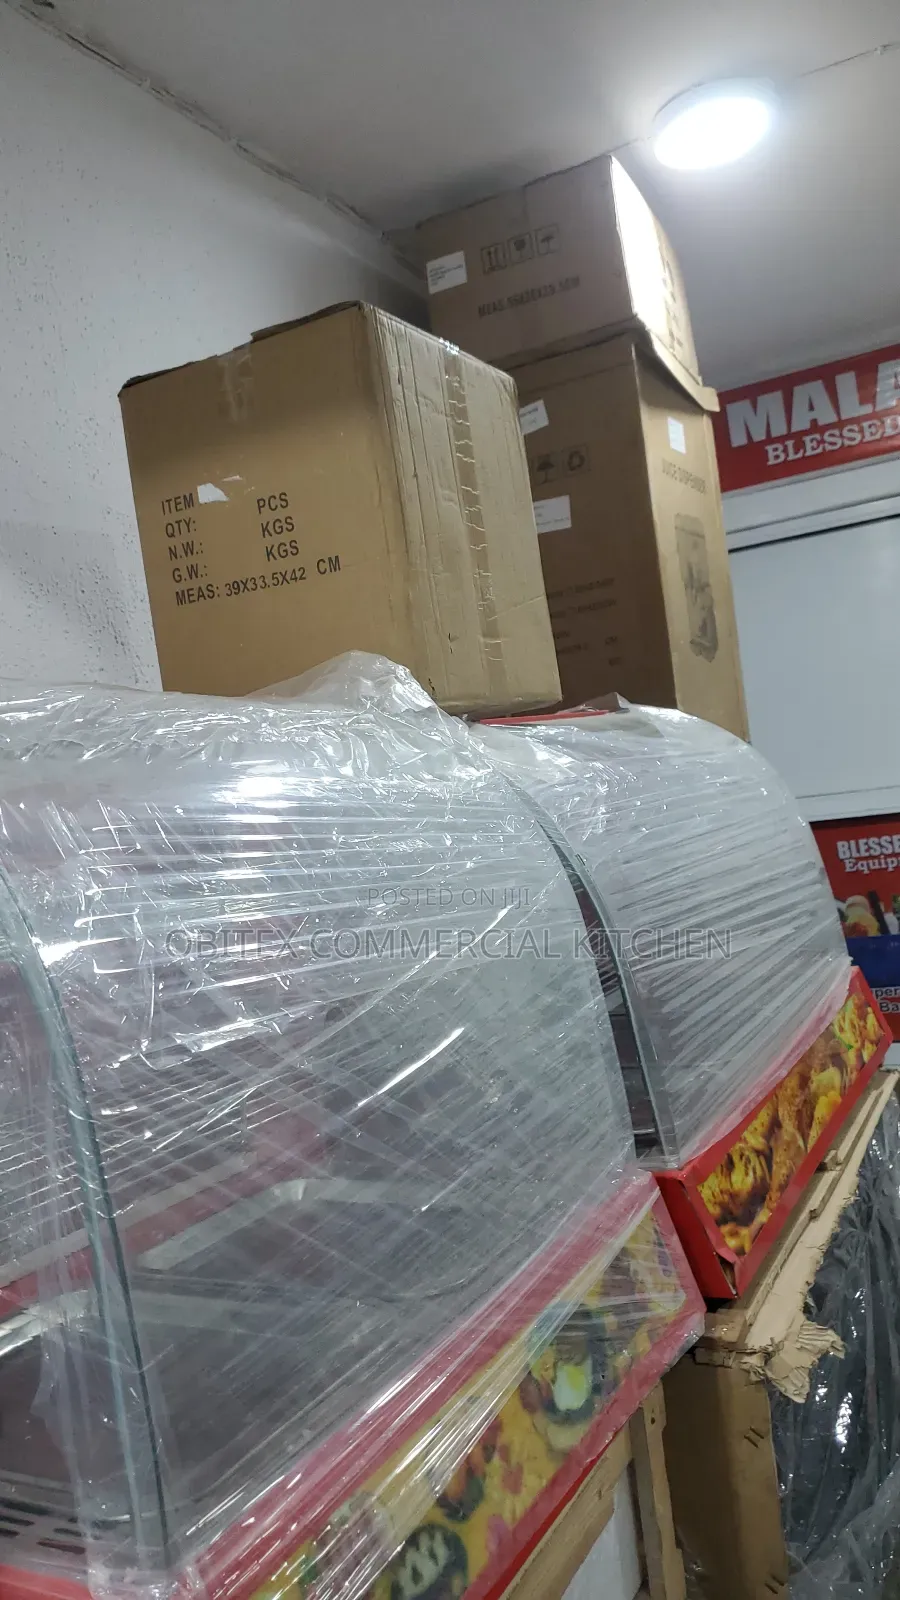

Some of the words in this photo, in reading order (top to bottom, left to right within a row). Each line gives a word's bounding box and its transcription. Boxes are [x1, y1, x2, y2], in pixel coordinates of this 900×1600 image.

[765, 415, 900, 466] BLESSED
[161, 493, 194, 516] ITEM
[165, 517, 197, 538] QTY:
[257, 492, 289, 514] PCS
[168, 540, 204, 561] N.W.:
[261, 516, 295, 538] KGS
[172, 563, 208, 583] G.W.:
[265, 540, 300, 562] KGS
[175, 585, 220, 606] MEAS:
[225, 566, 307, 597] 39X33.5X42
[316, 555, 341, 575] CM
